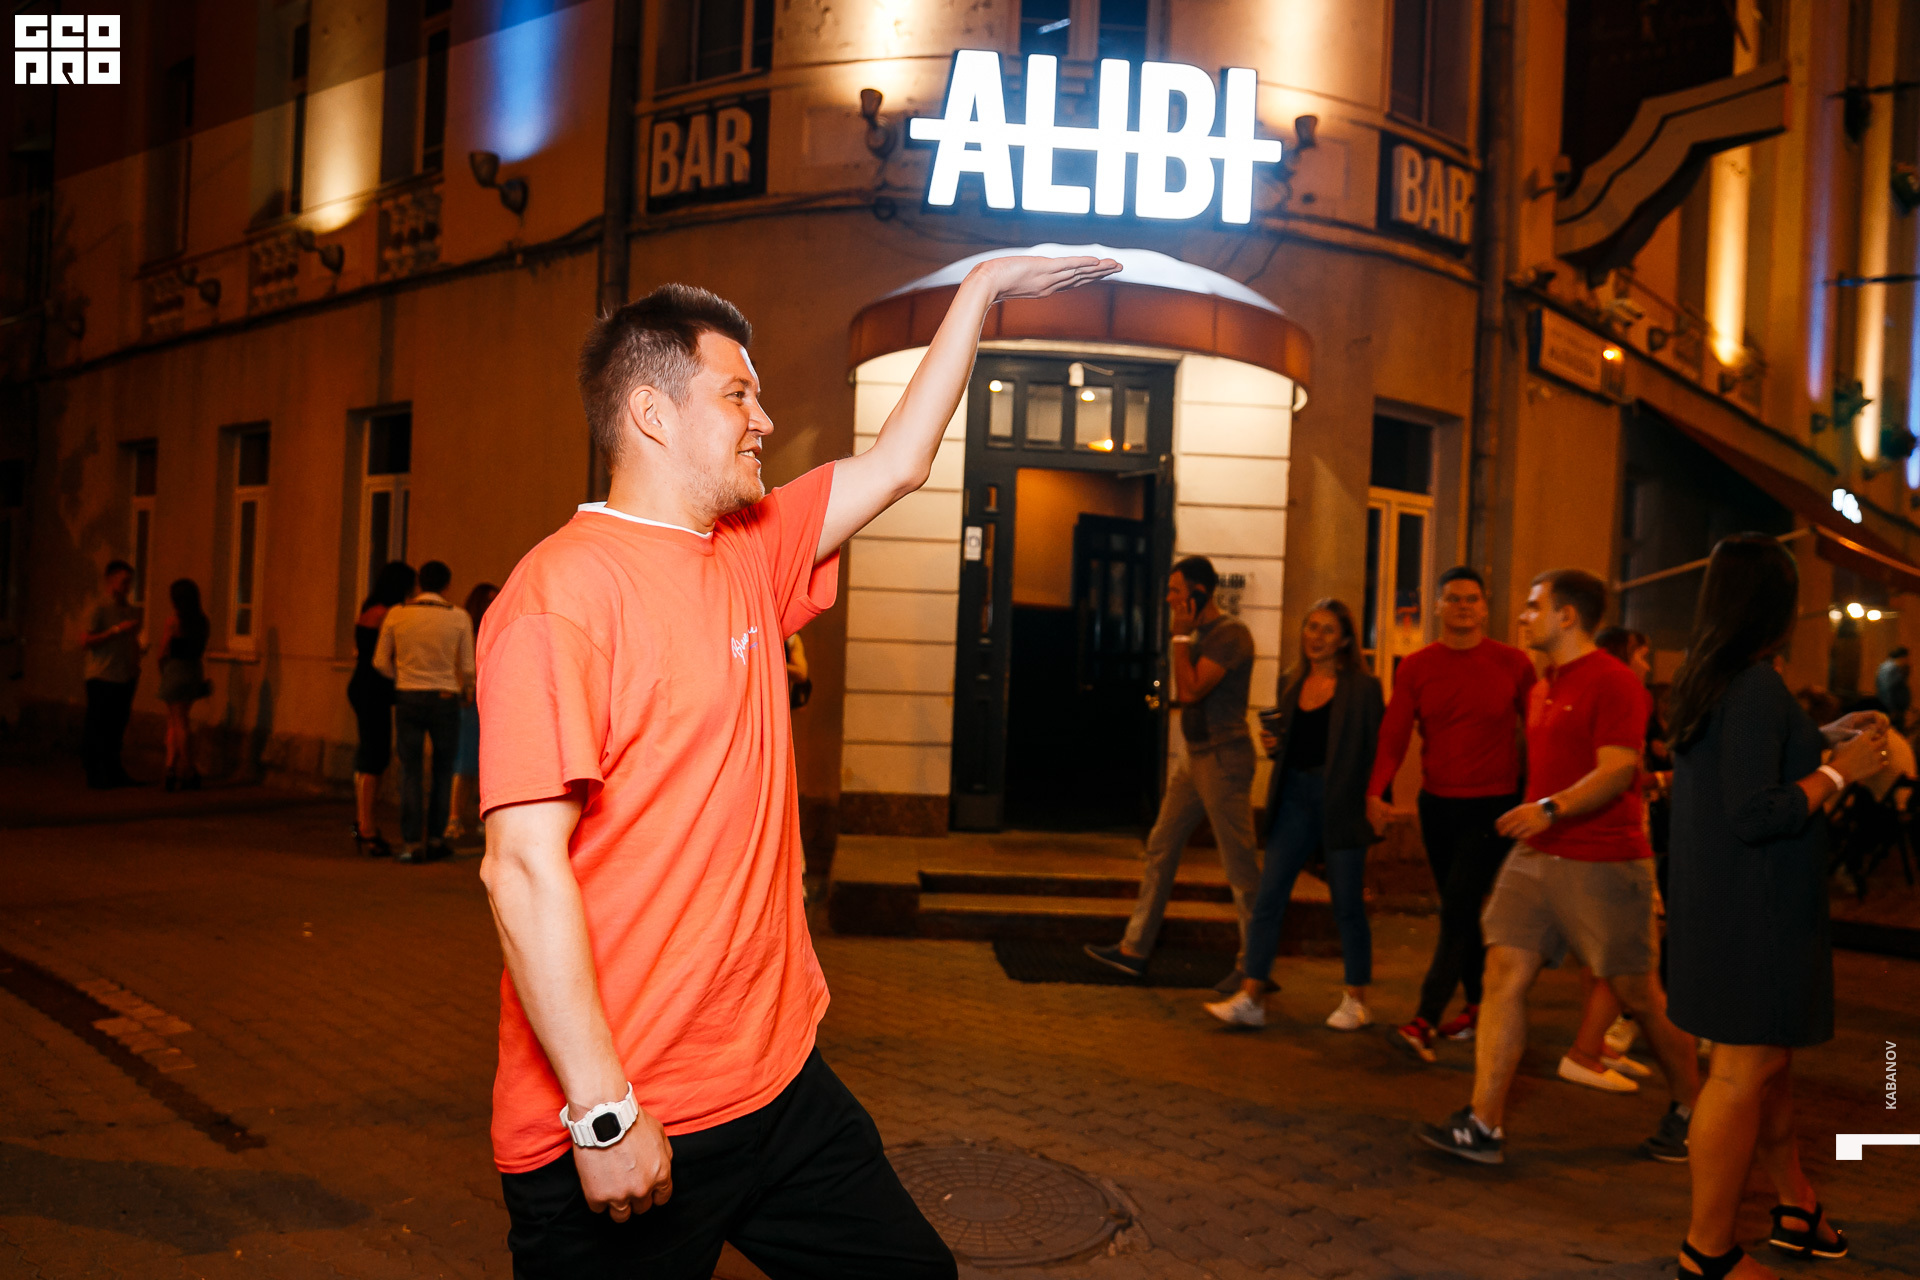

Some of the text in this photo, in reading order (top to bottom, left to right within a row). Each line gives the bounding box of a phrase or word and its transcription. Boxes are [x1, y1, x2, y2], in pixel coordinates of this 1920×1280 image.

[650, 107, 751, 197] BAR
[910, 50, 1282, 224] ALIBI
[1392, 144, 1476, 245] BAR
